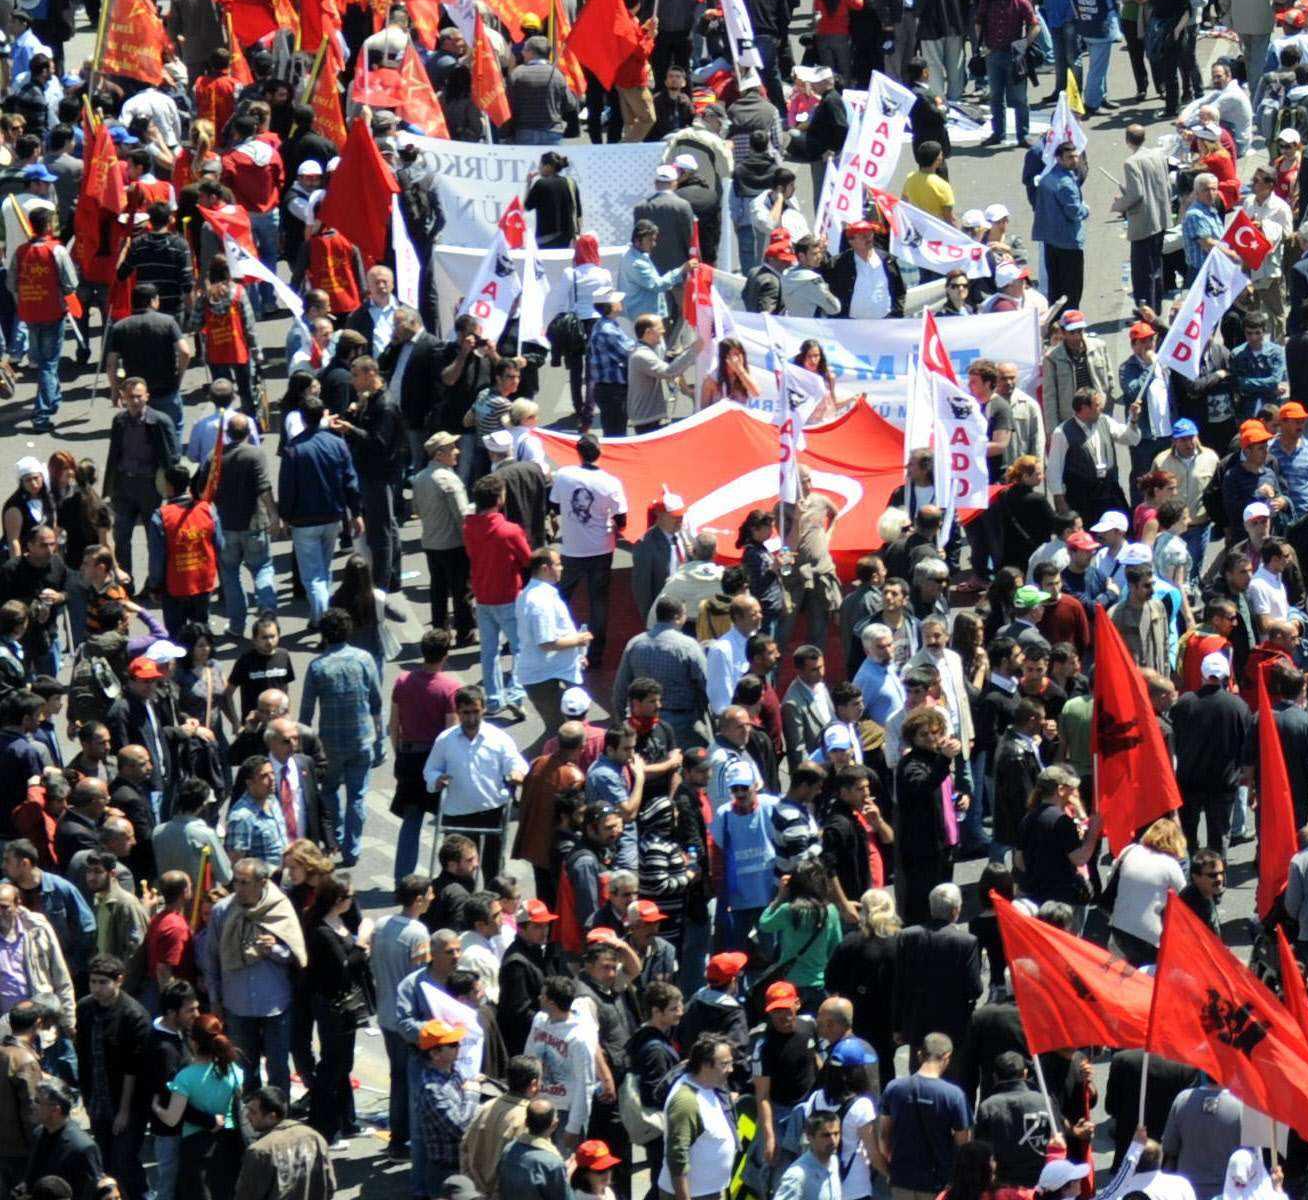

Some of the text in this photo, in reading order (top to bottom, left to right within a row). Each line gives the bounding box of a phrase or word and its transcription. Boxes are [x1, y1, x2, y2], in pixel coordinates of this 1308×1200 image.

[864, 121, 889, 178] ADD
[836, 154, 860, 212] ADD
[1171, 300, 1206, 362] ADD
[951, 426, 971, 498] ADD
